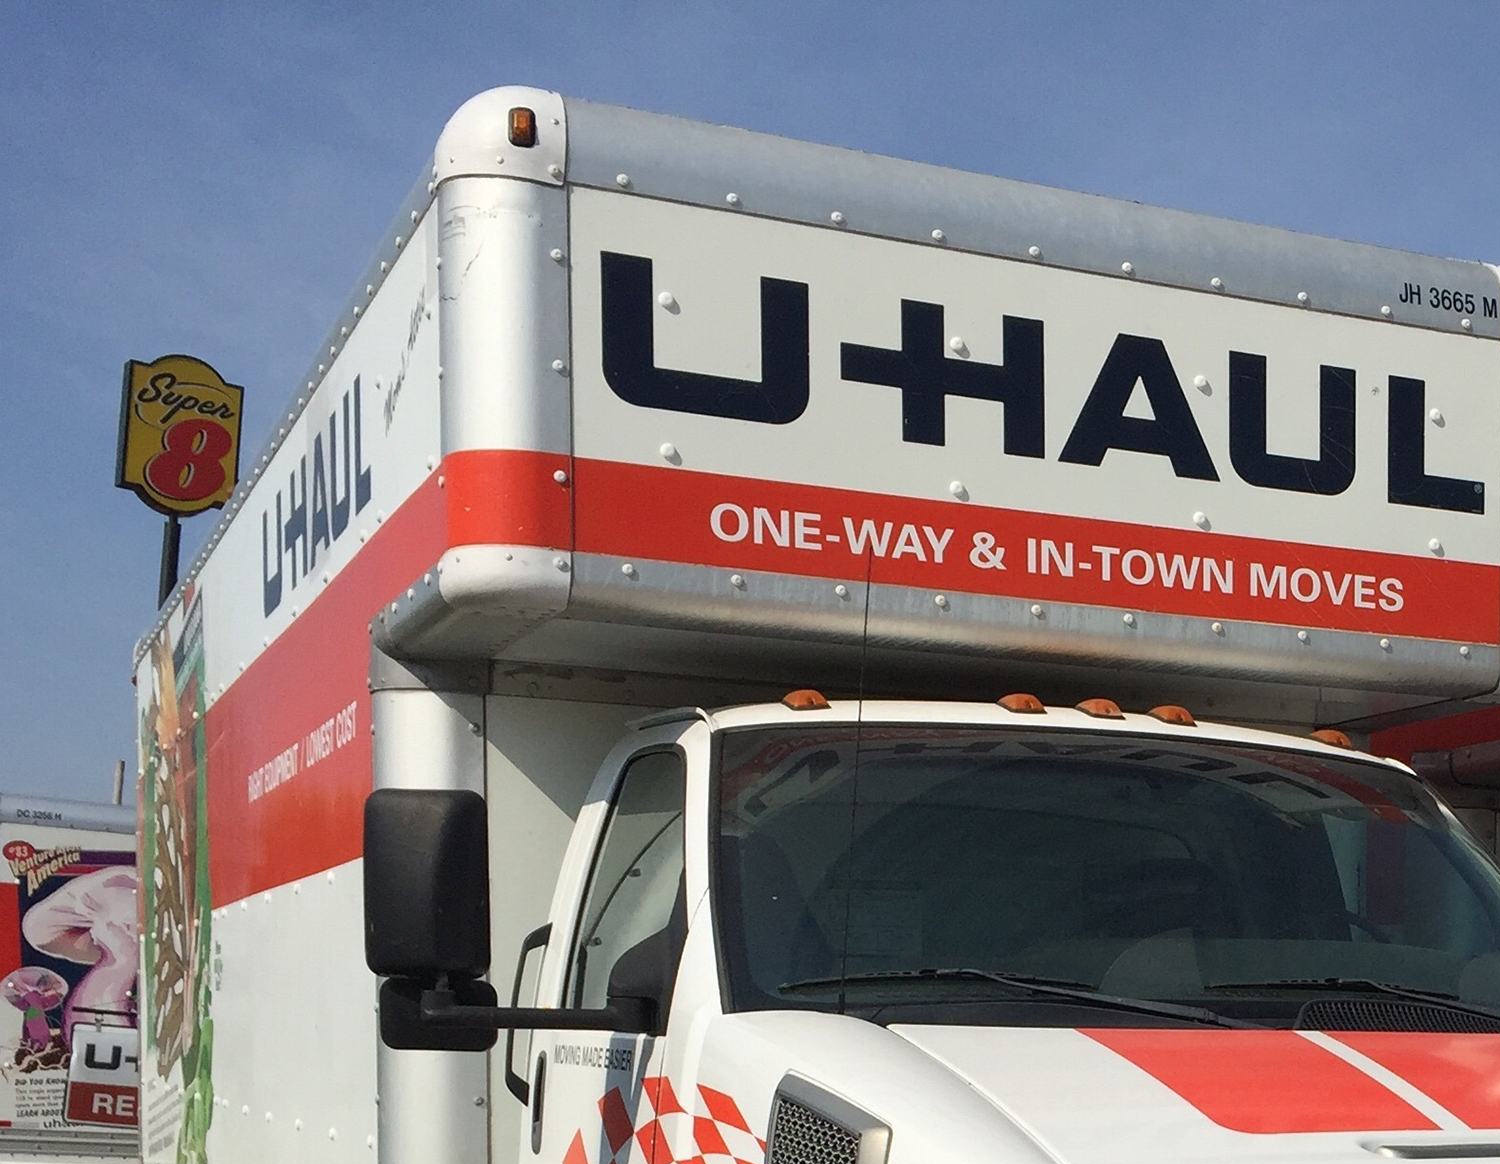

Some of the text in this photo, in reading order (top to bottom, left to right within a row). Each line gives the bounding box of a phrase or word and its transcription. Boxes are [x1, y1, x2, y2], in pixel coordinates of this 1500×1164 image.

[1399, 282, 1498, 319] JH 3665 M
[136, 372, 234, 425] Super
[600, 250, 1485, 515] U-HAUL
[142, 418, 233, 501] 8
[262, 373, 371, 618] U-HAUL
[710, 503, 1404, 612] ONE-WAY & IN-TOWN MOVES
[306, 717, 335, 768] LOWEST
[336, 700, 357, 748] COST
[9, 850, 55, 877] Venture
[27, 851, 81, 898] America
[554, 1044, 632, 1072] MOVING MADE EASIER
